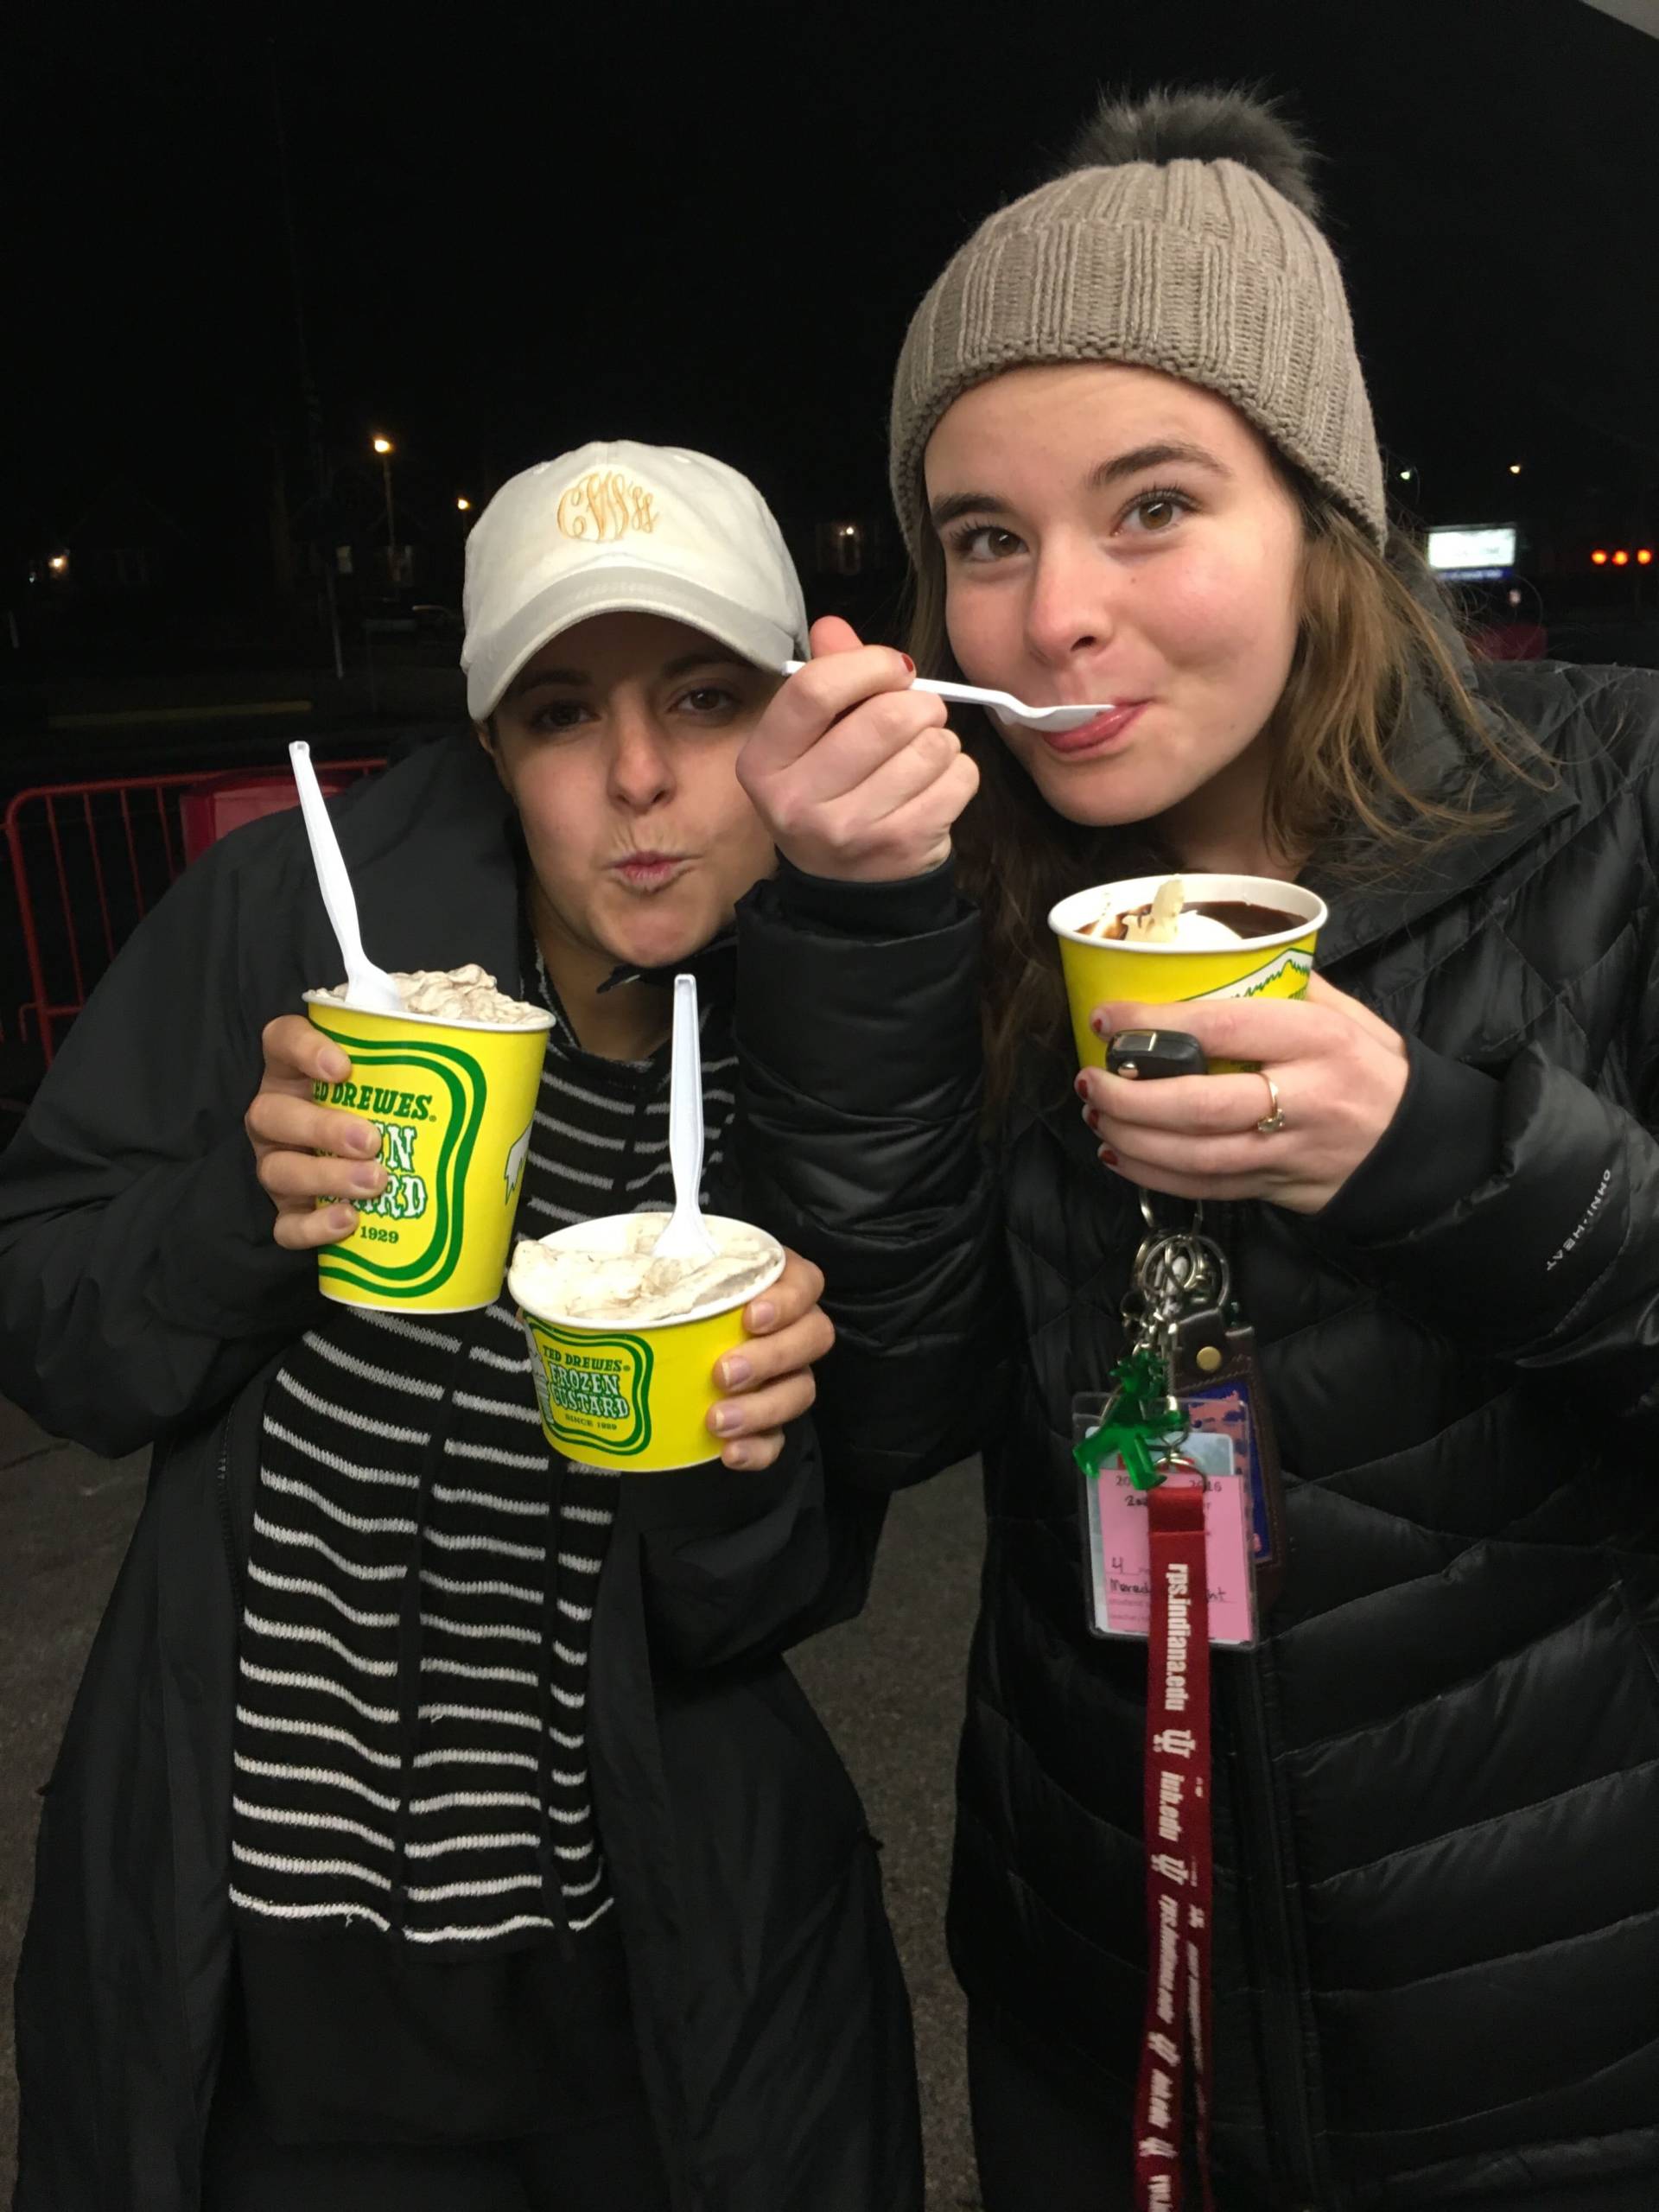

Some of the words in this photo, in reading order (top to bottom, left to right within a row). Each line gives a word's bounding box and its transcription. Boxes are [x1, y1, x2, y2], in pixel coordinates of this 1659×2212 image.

[330, 1082, 433, 1121] DREWES
[360, 1226, 400, 1244] 1929
[543, 1344, 563, 1362] TED
[565, 1353, 622, 1372] DREWES
[549, 1362, 620, 1397] FROZEN
[551, 1384, 630, 1420] CUSTARD
[1165, 1563, 1192, 1712] rps.indiana.edu
[1159, 1771, 1185, 1842] iub.edu
